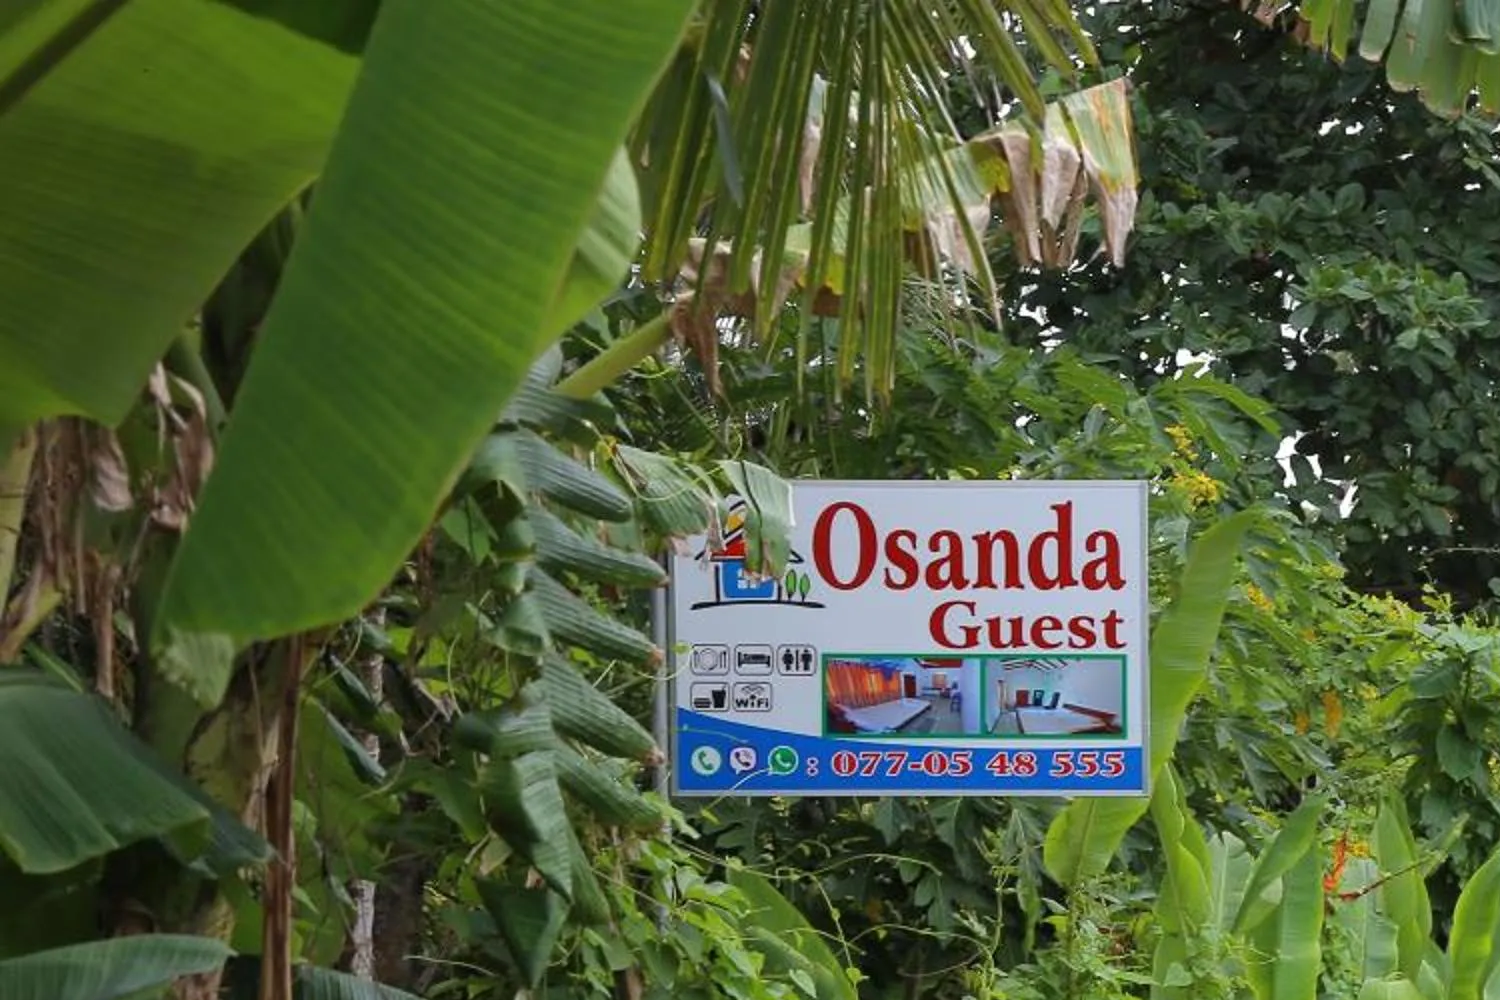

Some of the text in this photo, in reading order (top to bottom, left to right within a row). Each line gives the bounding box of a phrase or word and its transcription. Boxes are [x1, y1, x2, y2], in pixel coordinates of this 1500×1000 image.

[812, 500, 1127, 591] Osanda
[929, 600, 1127, 650] Guest
[831, 750, 973, 777] 077-05
[986, 751, 1038, 777] 48
[1049, 751, 1125, 777] 555
